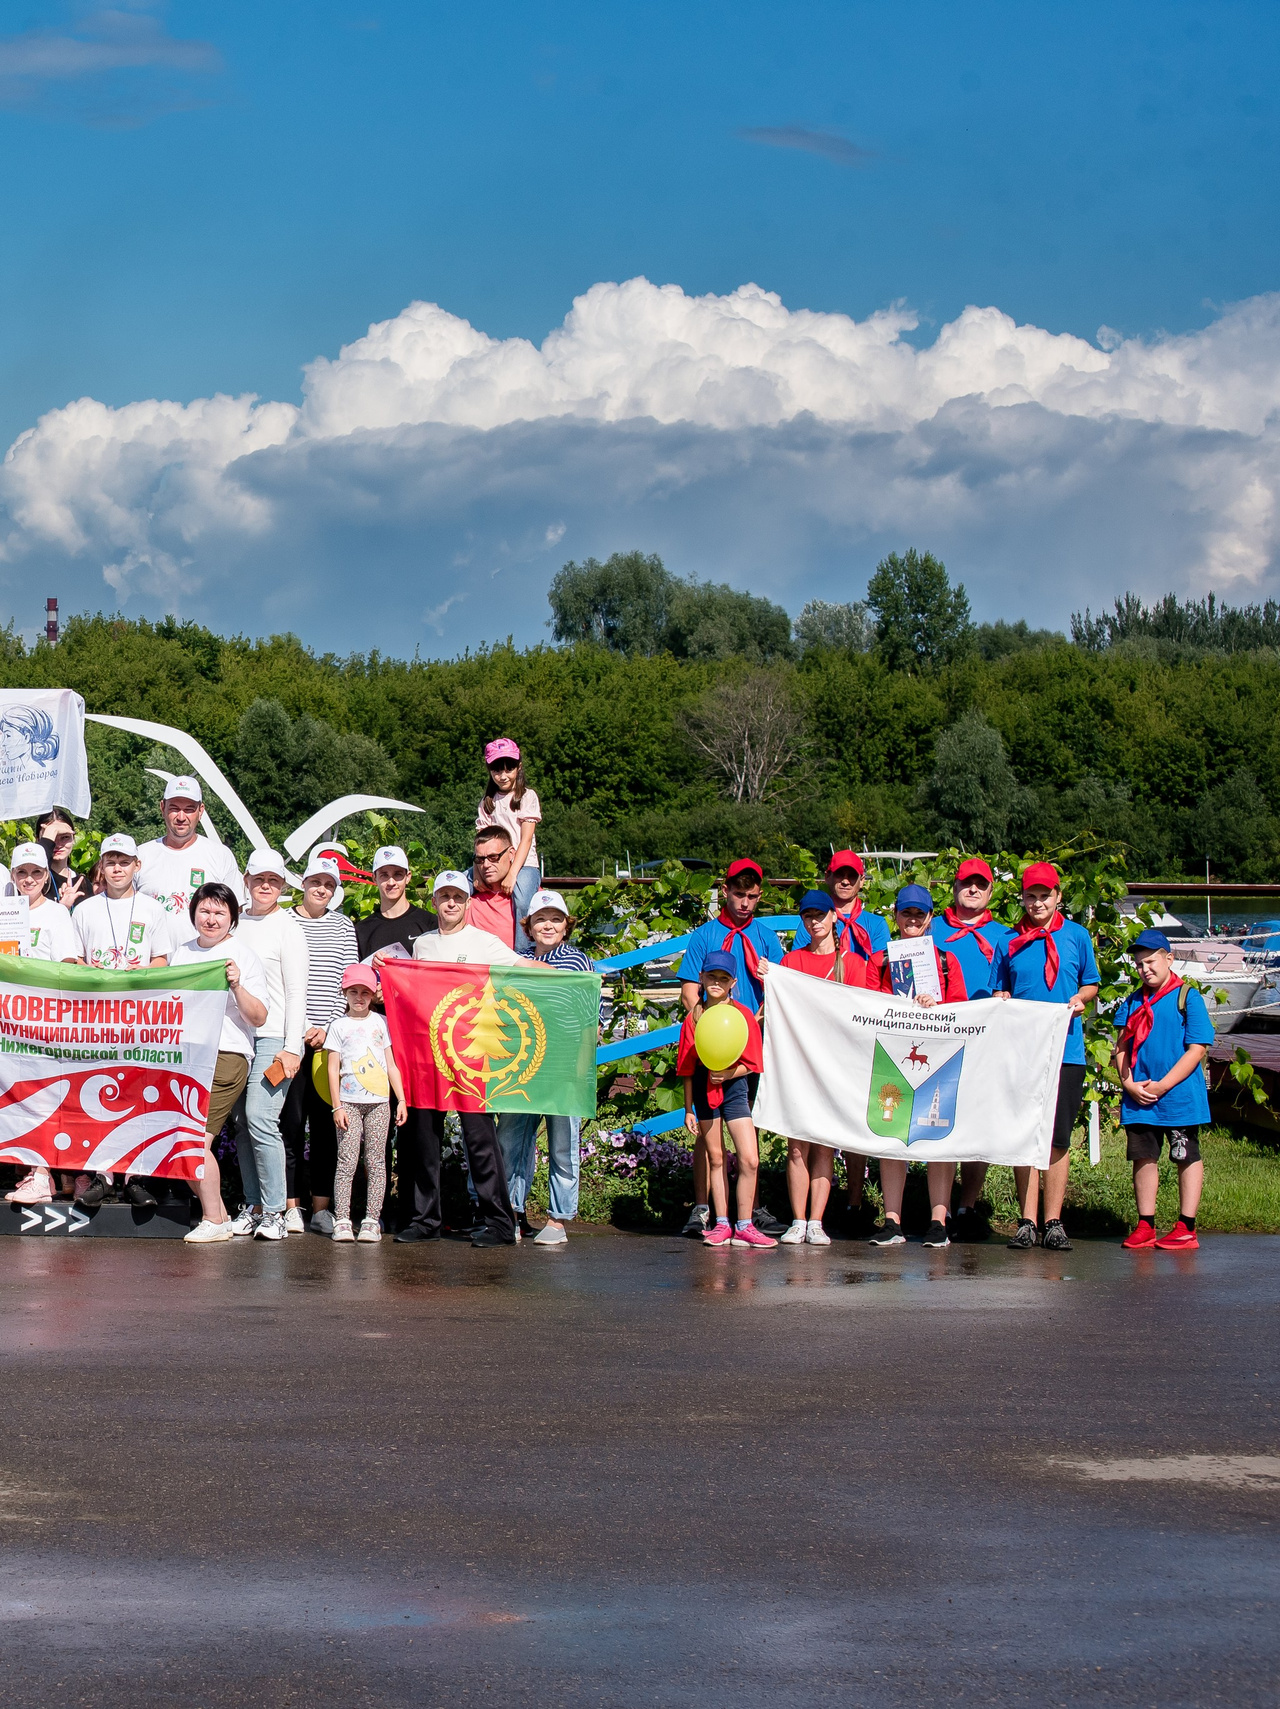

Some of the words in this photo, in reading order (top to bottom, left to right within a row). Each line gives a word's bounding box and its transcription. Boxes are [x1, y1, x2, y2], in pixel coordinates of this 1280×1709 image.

[884, 1008, 956, 1023] Дивеевский
[852, 1014, 951, 1034] муниципальный
[953, 1024, 987, 1036] округ
[139, 1028, 184, 1045] ОКРУГ
[123, 1047, 183, 1064] области
